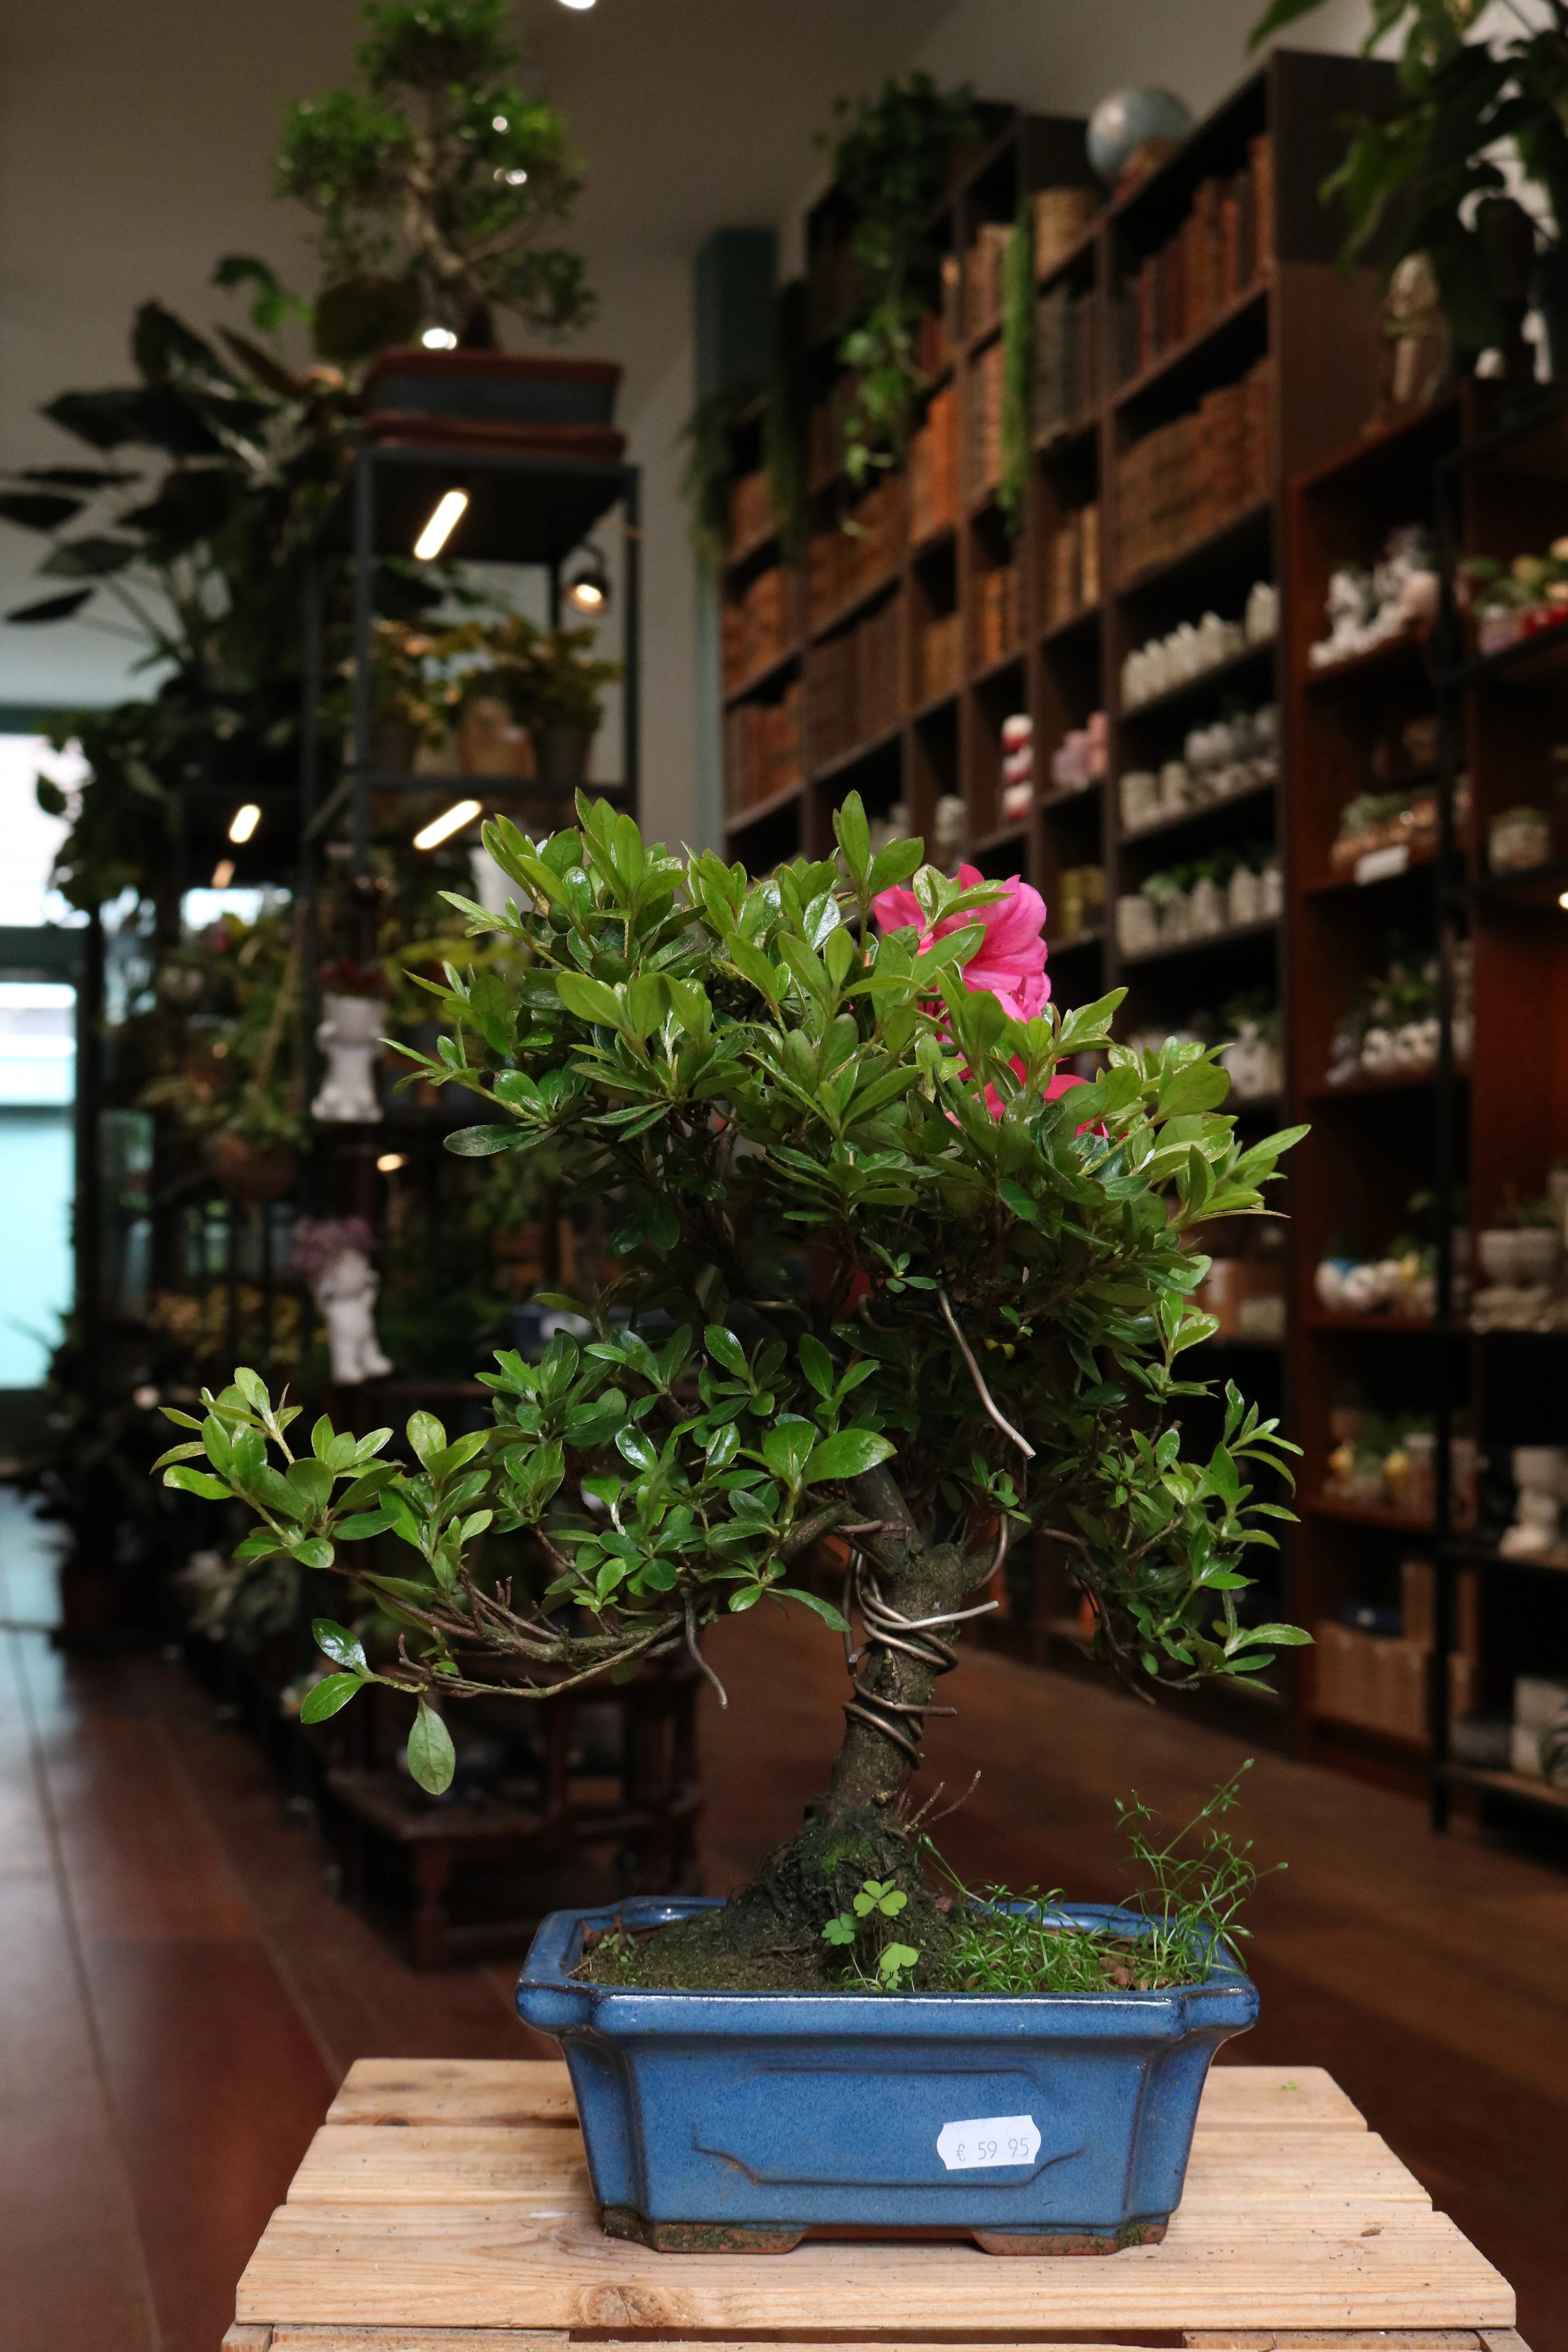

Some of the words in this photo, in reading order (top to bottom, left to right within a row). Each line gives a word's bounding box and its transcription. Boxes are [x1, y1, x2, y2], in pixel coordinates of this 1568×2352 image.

[956, 2143, 966, 2162] €
[978, 2141, 997, 2160] 59
[1008, 2137, 1029, 2158] 95
